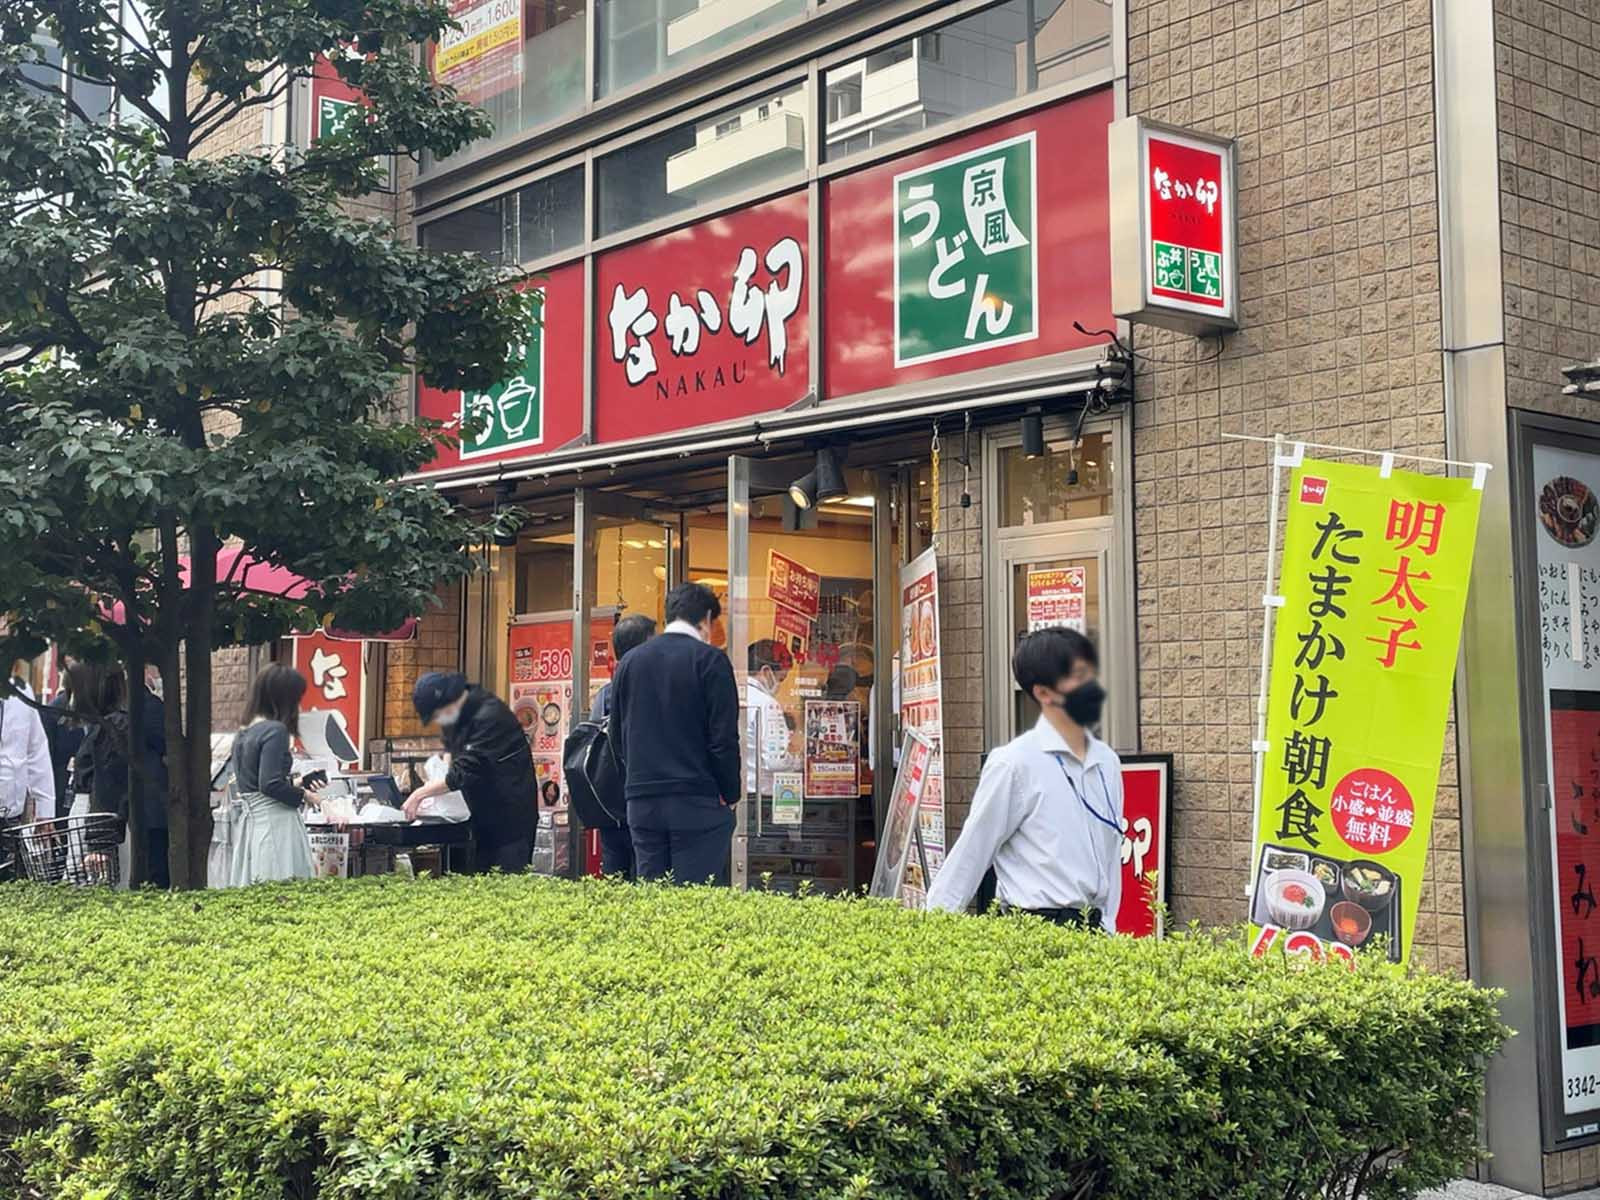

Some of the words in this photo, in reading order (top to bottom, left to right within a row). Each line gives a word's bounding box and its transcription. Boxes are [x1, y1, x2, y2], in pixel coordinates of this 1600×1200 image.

[970, 169, 1010, 249] 京風
[1154, 167, 1218, 216] なか卯
[903, 183, 1013, 340] うどん
[609, 237, 804, 386] なか卯
[656, 360, 746, 401] NAKAU
[1366, 498, 1447, 668] 明太子
[540, 649, 572, 680] 580
[1275, 511, 1364, 849] たまかけ朝食
[1350, 779, 1398, 805] ごはん
[1345, 816, 1391, 848] 無料
